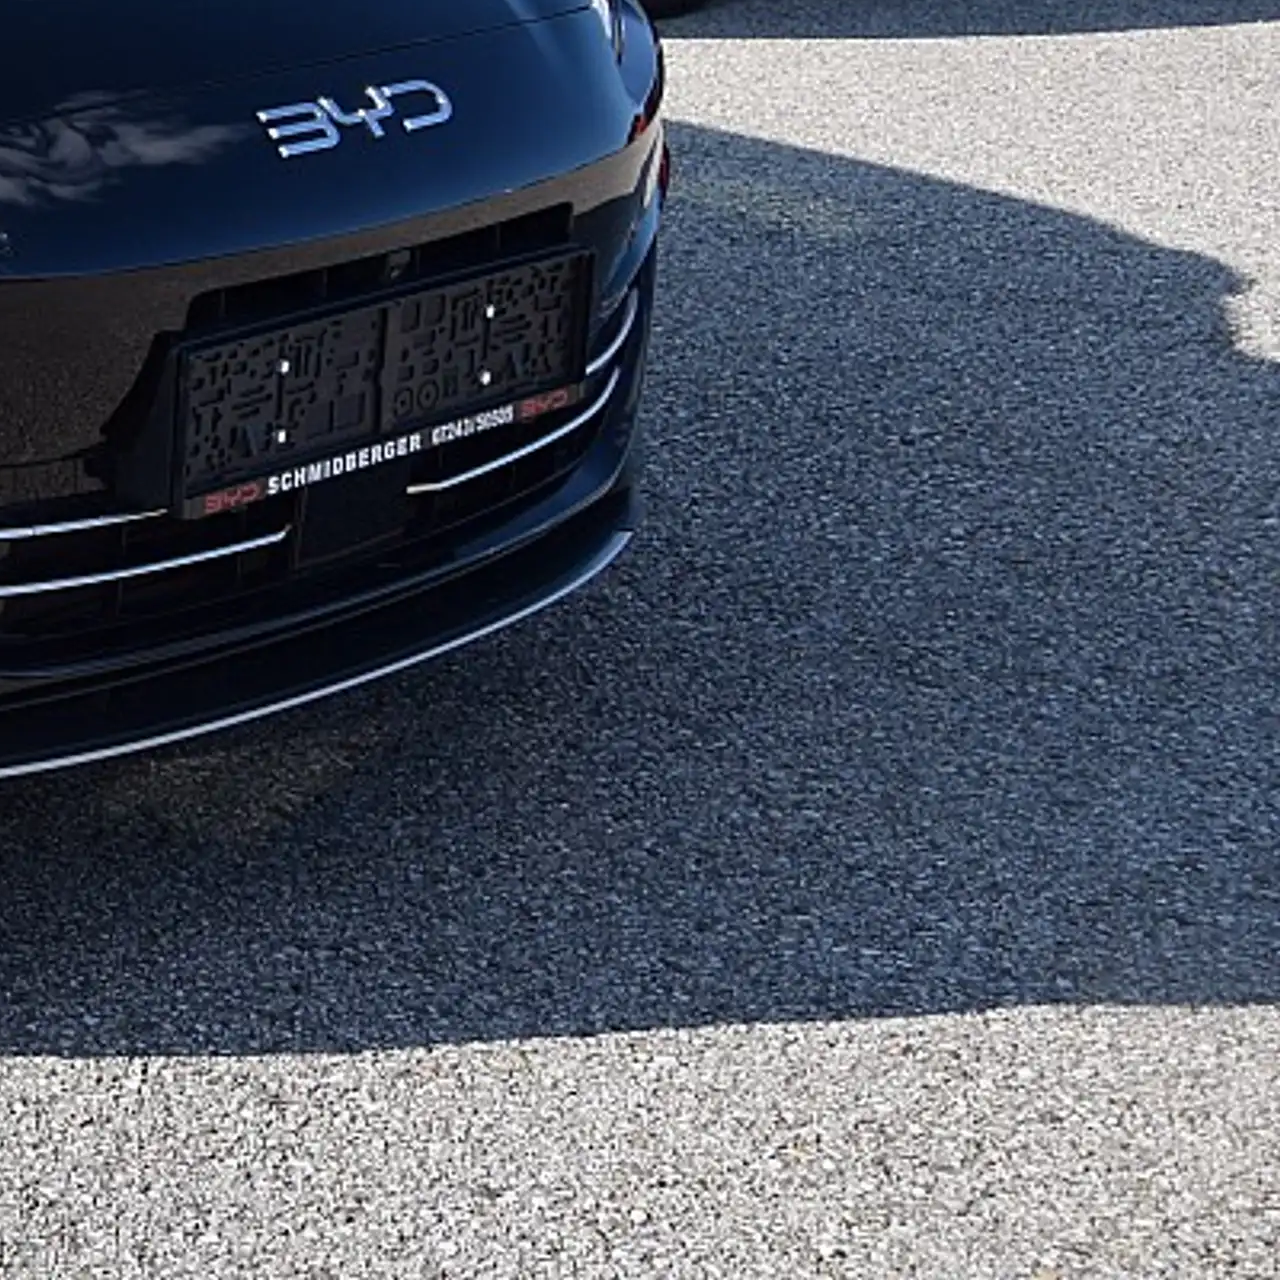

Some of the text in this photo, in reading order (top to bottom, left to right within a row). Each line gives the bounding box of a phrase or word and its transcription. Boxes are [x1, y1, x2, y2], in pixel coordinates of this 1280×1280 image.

[256, 79, 453, 159] BYD
[203, 483, 260, 513] BYD
[266, 433, 421, 495] SCHMIDBERGER
